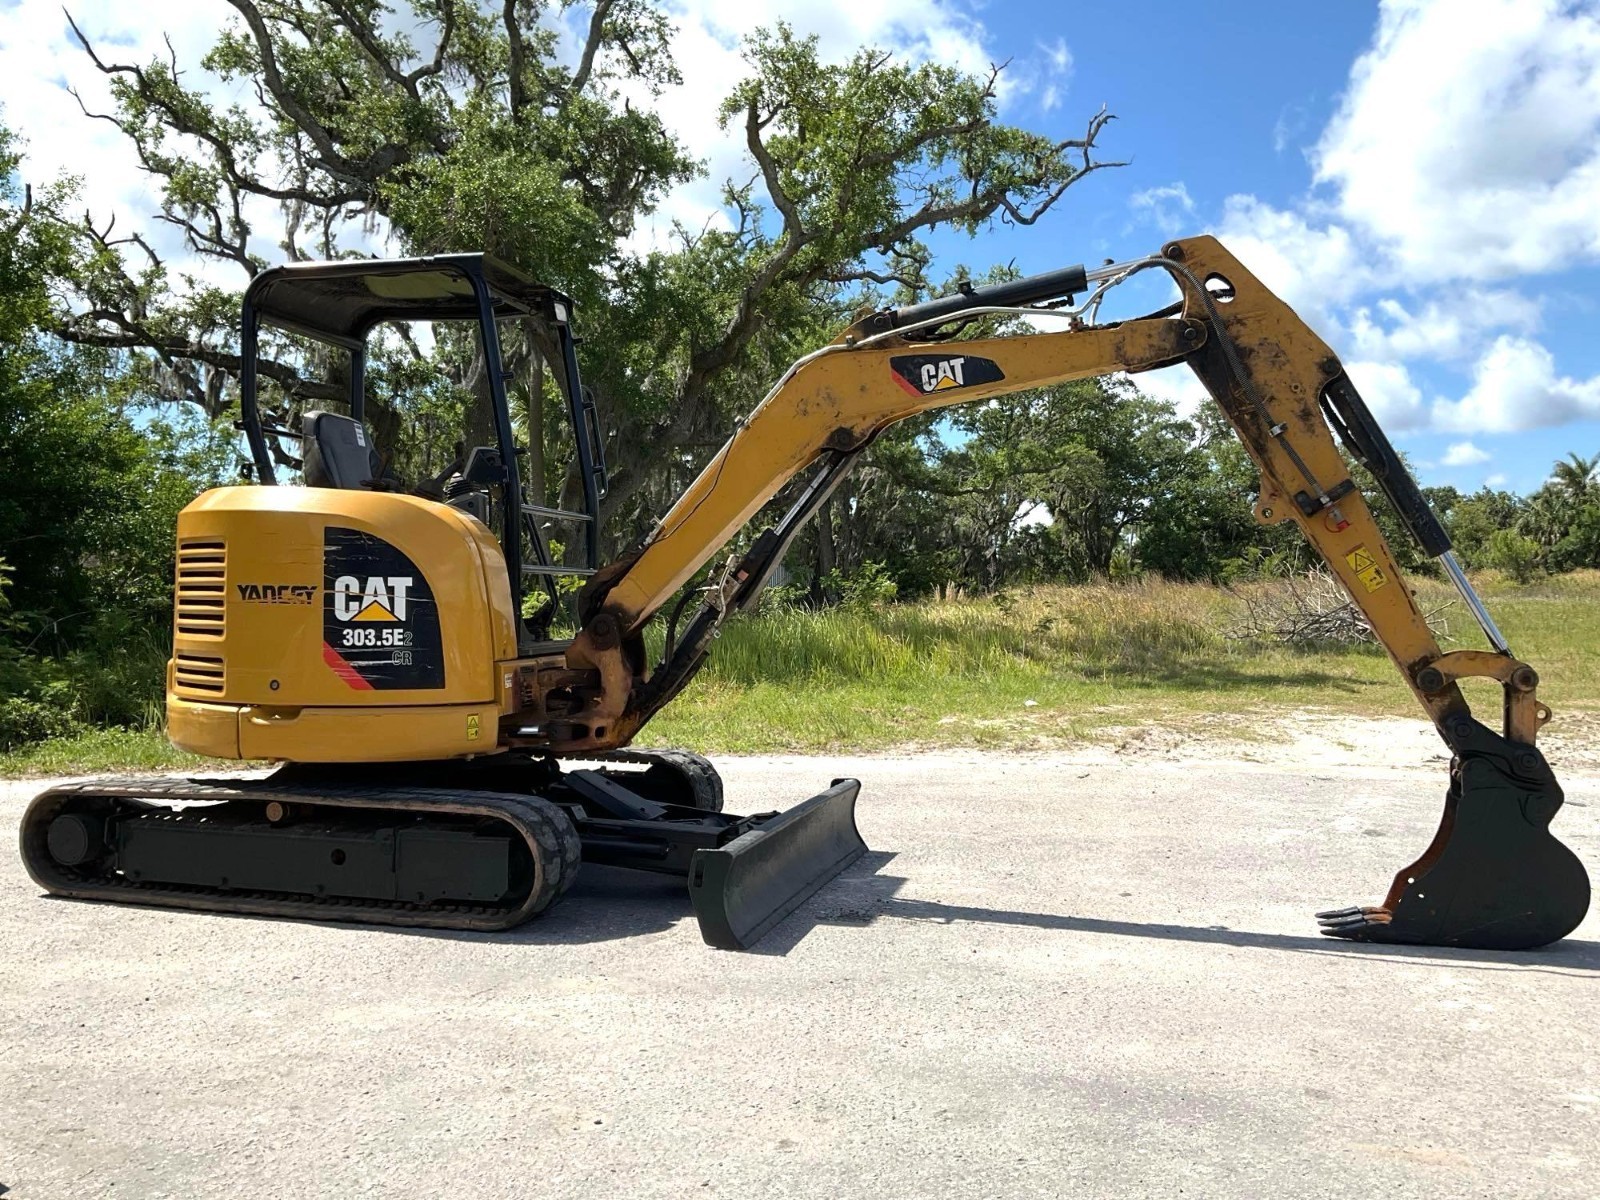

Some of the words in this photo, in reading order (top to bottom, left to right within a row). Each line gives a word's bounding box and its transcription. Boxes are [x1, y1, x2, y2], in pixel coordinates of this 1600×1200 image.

[920, 357, 965, 392] CAT
[334, 575, 413, 622] CAT
[342, 628, 413, 646] 303.5E2
[391, 650, 413, 666] CR
